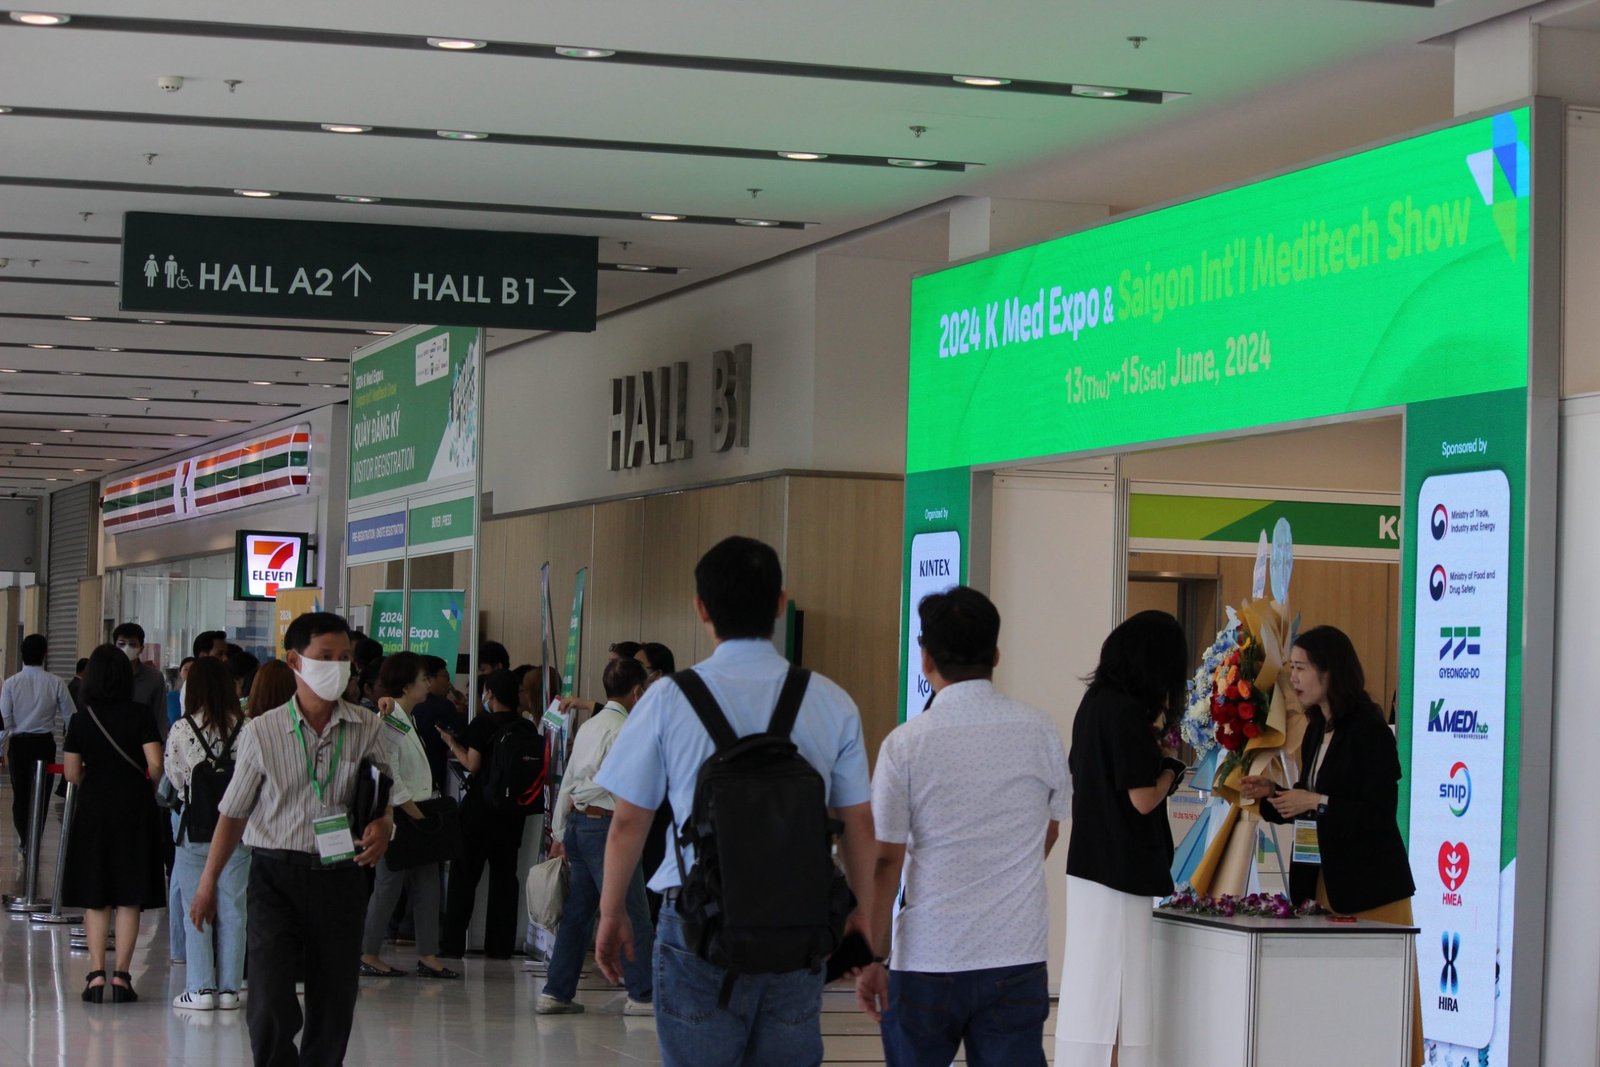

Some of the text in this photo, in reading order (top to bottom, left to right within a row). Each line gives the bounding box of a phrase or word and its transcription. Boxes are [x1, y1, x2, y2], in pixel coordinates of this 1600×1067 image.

[200, 263, 535, 305] HALL A2 HALL B1
[939, 195, 1472, 358] 2024 K Med Expo & Saigon Int'l Meditech Show
[1170, 347, 1220, 386] June,
[1225, 330, 1271, 377] 2024
[608, 361, 693, 471] HALL
[1442, 437, 1487, 458] Sponsored by
[353, 446, 415, 484] VISITOR REGISTRATION
[924, 507, 949, 521] Organized by
[1451, 508, 1489, 520] Ministry of Trade,
[1451, 521, 1496, 534] Industry and Energy
[254, 541, 293, 597] 7
[919, 559, 950, 577] KINTEX
[1449, 570, 1495, 582] Ministry of Food and
[1449, 584, 1476, 595] Drug Safety
[380, 612, 403, 623] 2024
[378, 626, 439, 640] K Me Expo &
[1439, 667, 1480, 679] GYEONGGI-DO
[1440, 784, 1466, 804] snip
[1442, 893, 1462, 906] HMEA
[1438, 996, 1458, 1012] HIRA
